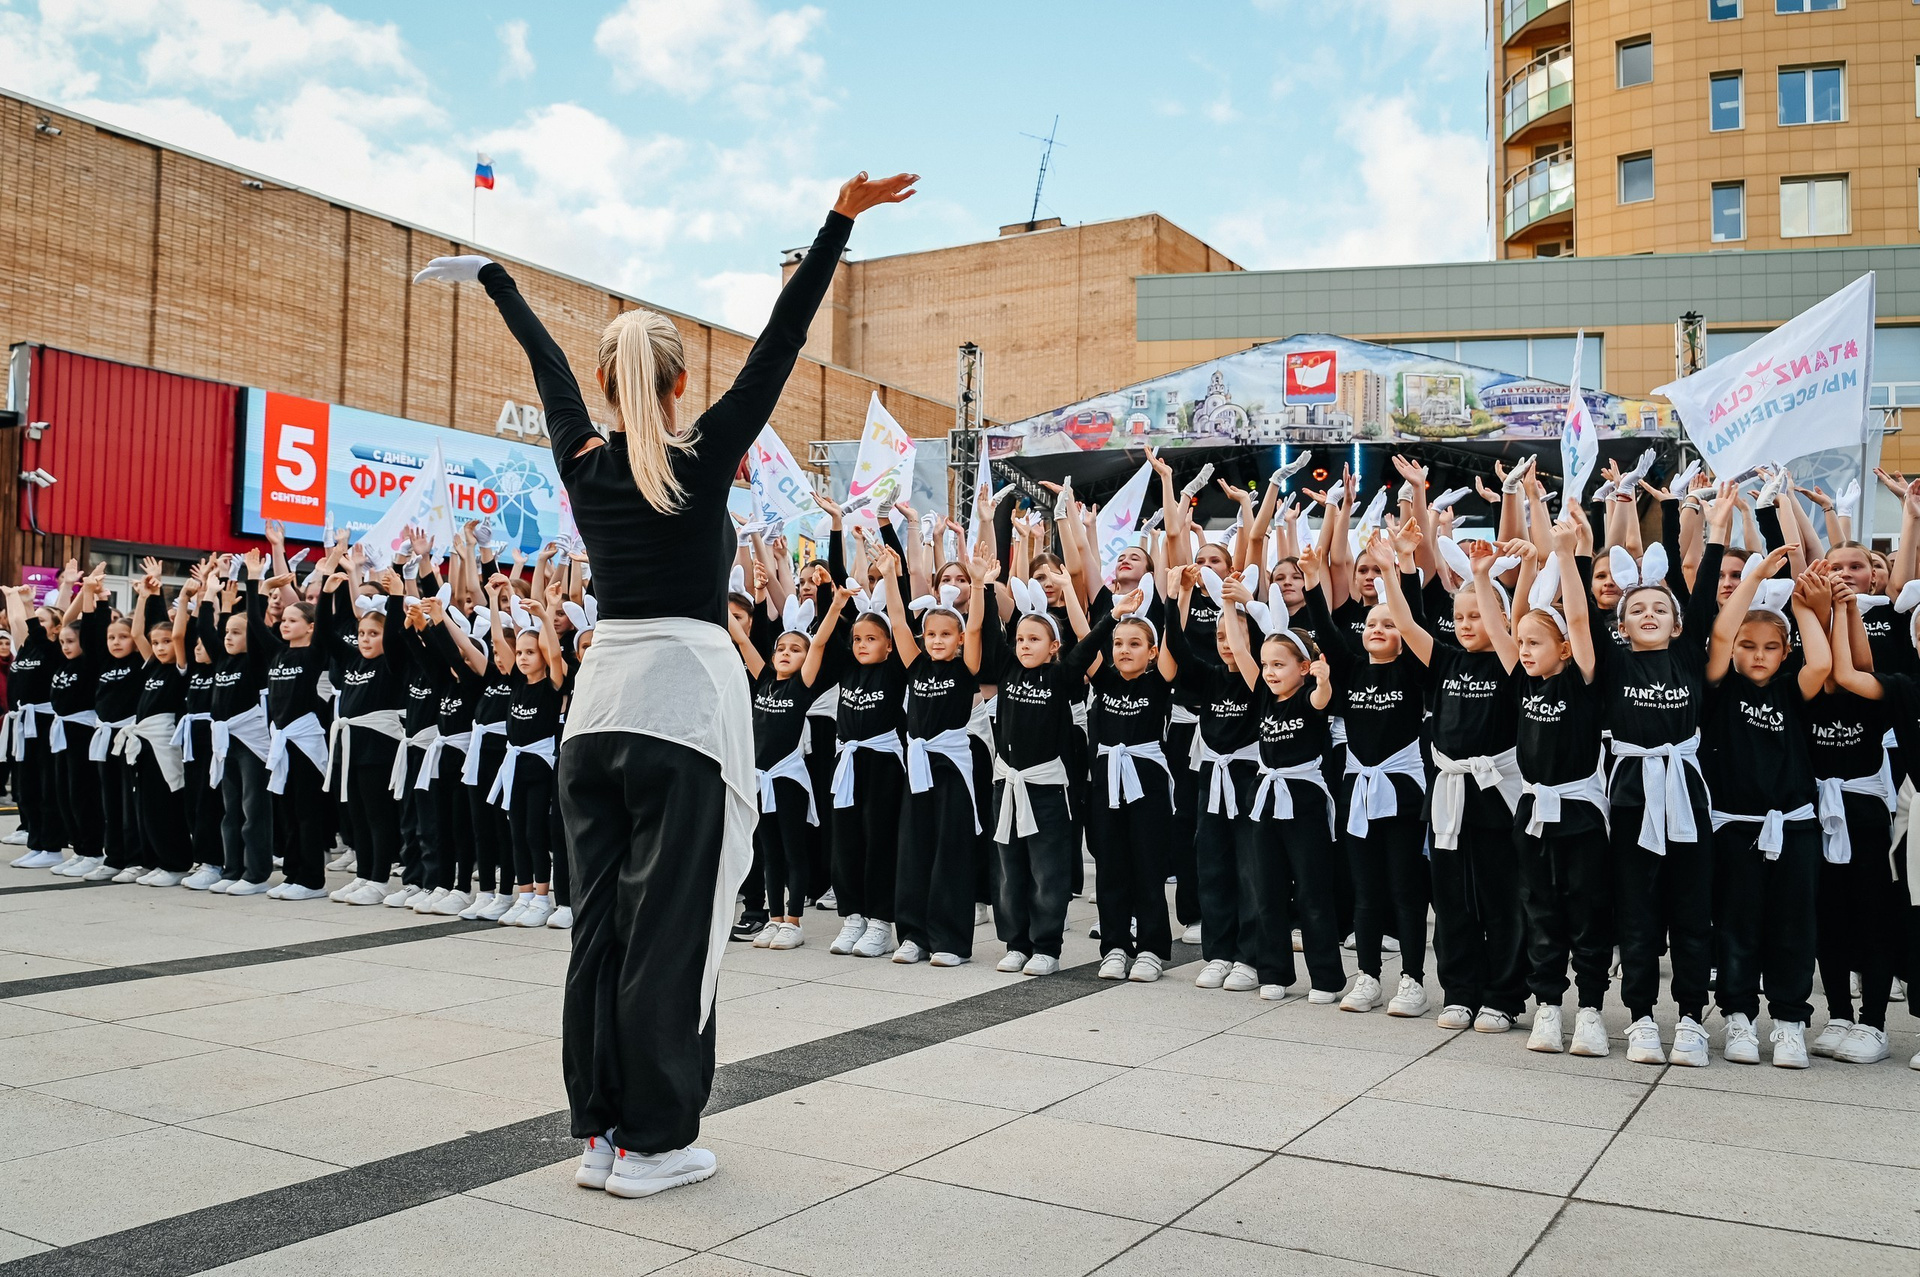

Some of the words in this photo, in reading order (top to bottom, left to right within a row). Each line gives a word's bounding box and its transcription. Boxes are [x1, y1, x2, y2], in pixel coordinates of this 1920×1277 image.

[275, 423, 317, 491] 5
[372, 449, 382, 461] С
[382, 452, 416, 468] ДНЁМ
[270, 491, 319, 507] СЕНТЯБРЯ
[1374, 690, 1404, 704] CLASS
[1623, 686, 1655, 701] TANZ
